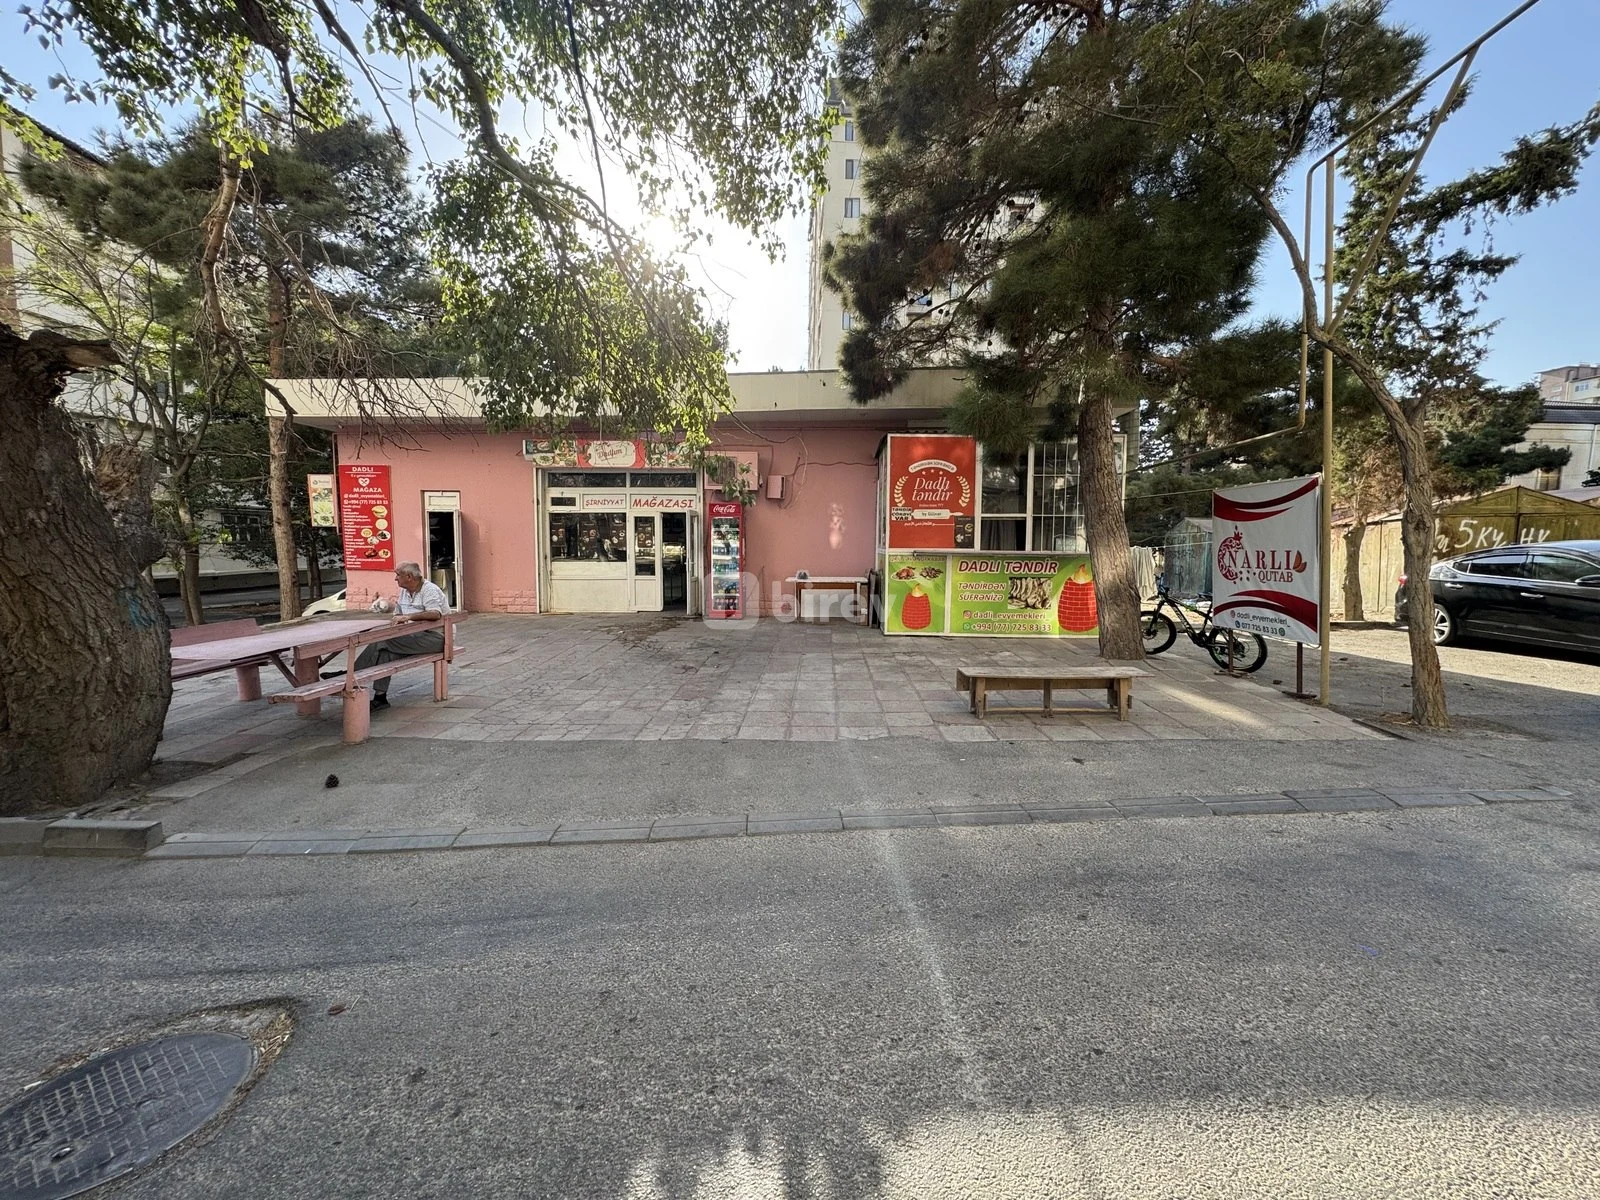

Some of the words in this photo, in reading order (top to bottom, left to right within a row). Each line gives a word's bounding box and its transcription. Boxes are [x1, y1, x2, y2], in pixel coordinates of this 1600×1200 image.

[912, 489, 953, 501] təndir
[586, 498, 625, 507] ŞİRNİYYAT
[633, 496, 694, 508] MAĞAZASI
[713, 505, 736, 514] Coca-Cola
[959, 561, 1000, 573] DADLI
[1005, 559, 1057, 573] TƏNDİR
[1228, 550, 1292, 570] NARLI
[1258, 570, 1293, 583] QUTAB
[958, 582, 1006, 590] TƏNDİRDƏN
[994, 623, 1010, 631] (77)
